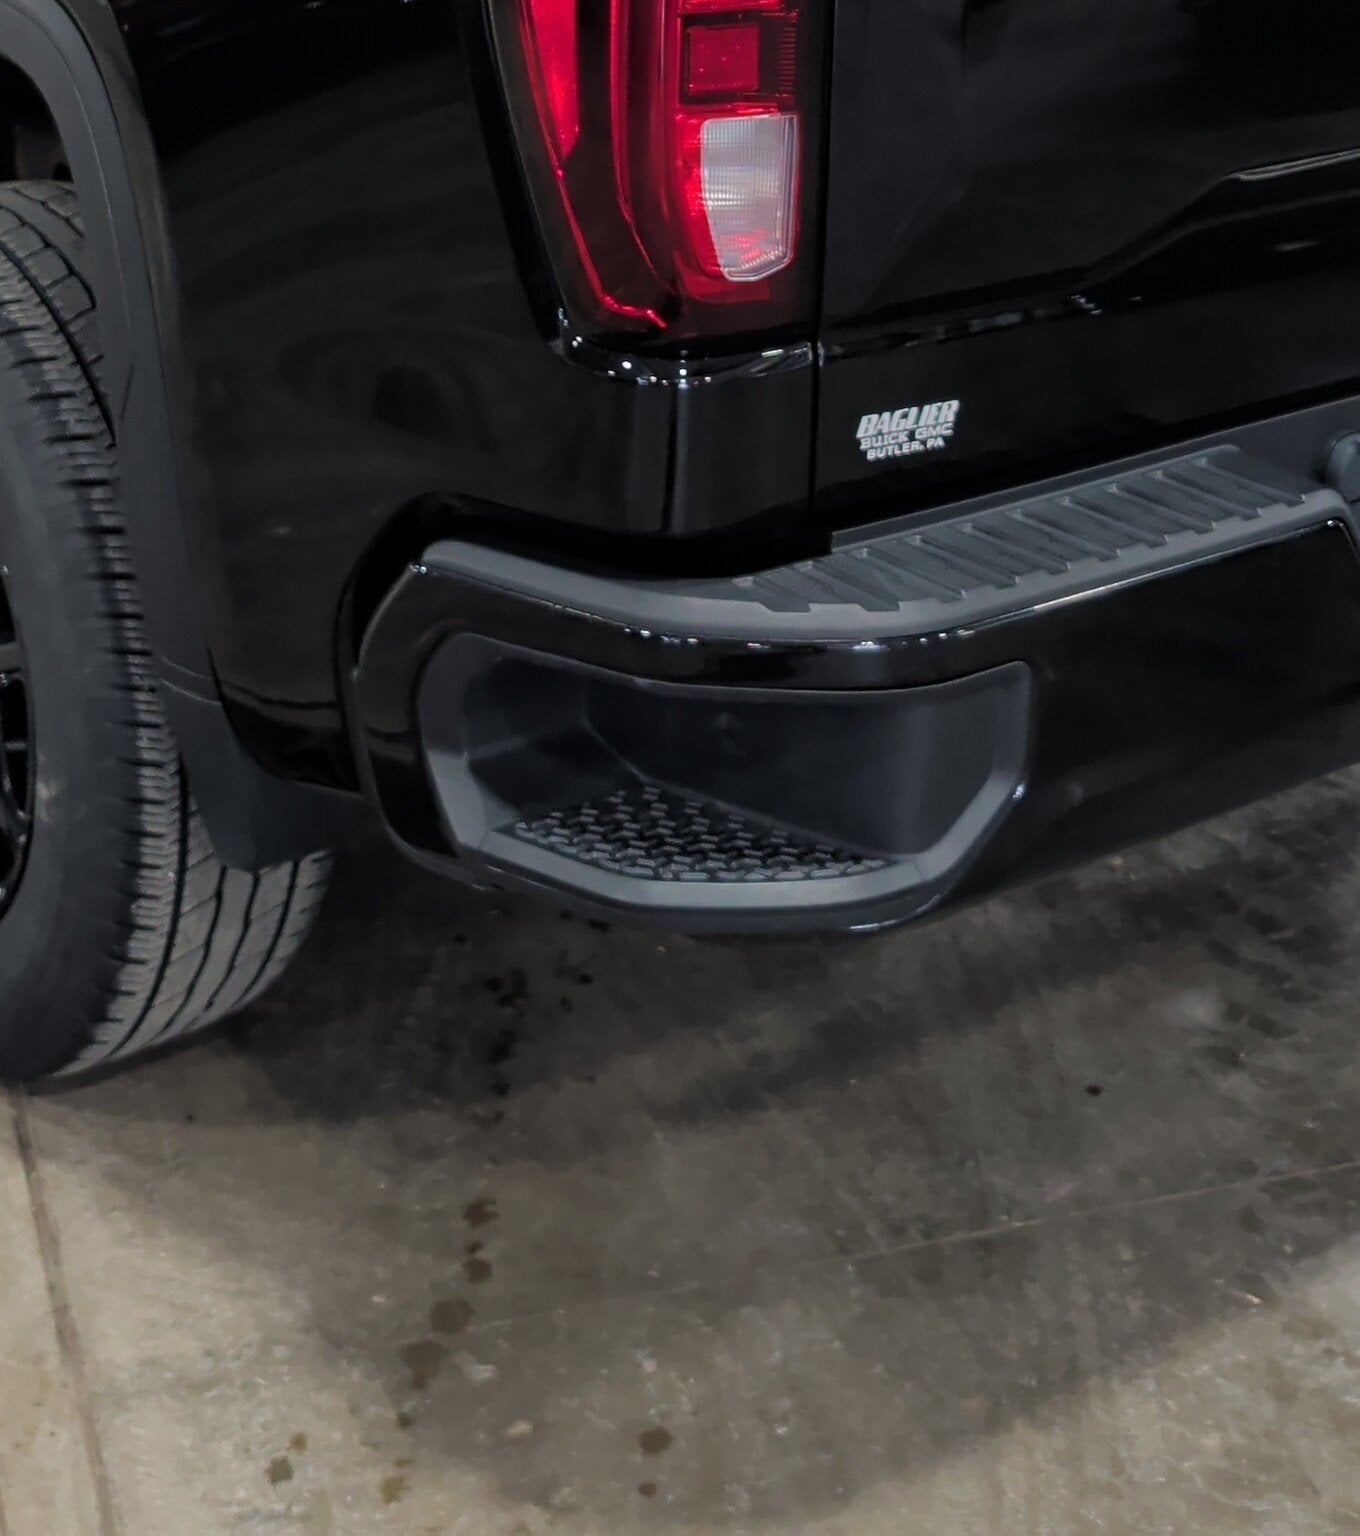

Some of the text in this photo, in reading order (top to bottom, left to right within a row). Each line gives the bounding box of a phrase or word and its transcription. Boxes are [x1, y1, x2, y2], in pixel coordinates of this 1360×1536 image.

[856, 399, 960, 438] BAGLIER
[860, 423, 954, 450] BUICK GMC
[926, 437, 945, 451] PA
